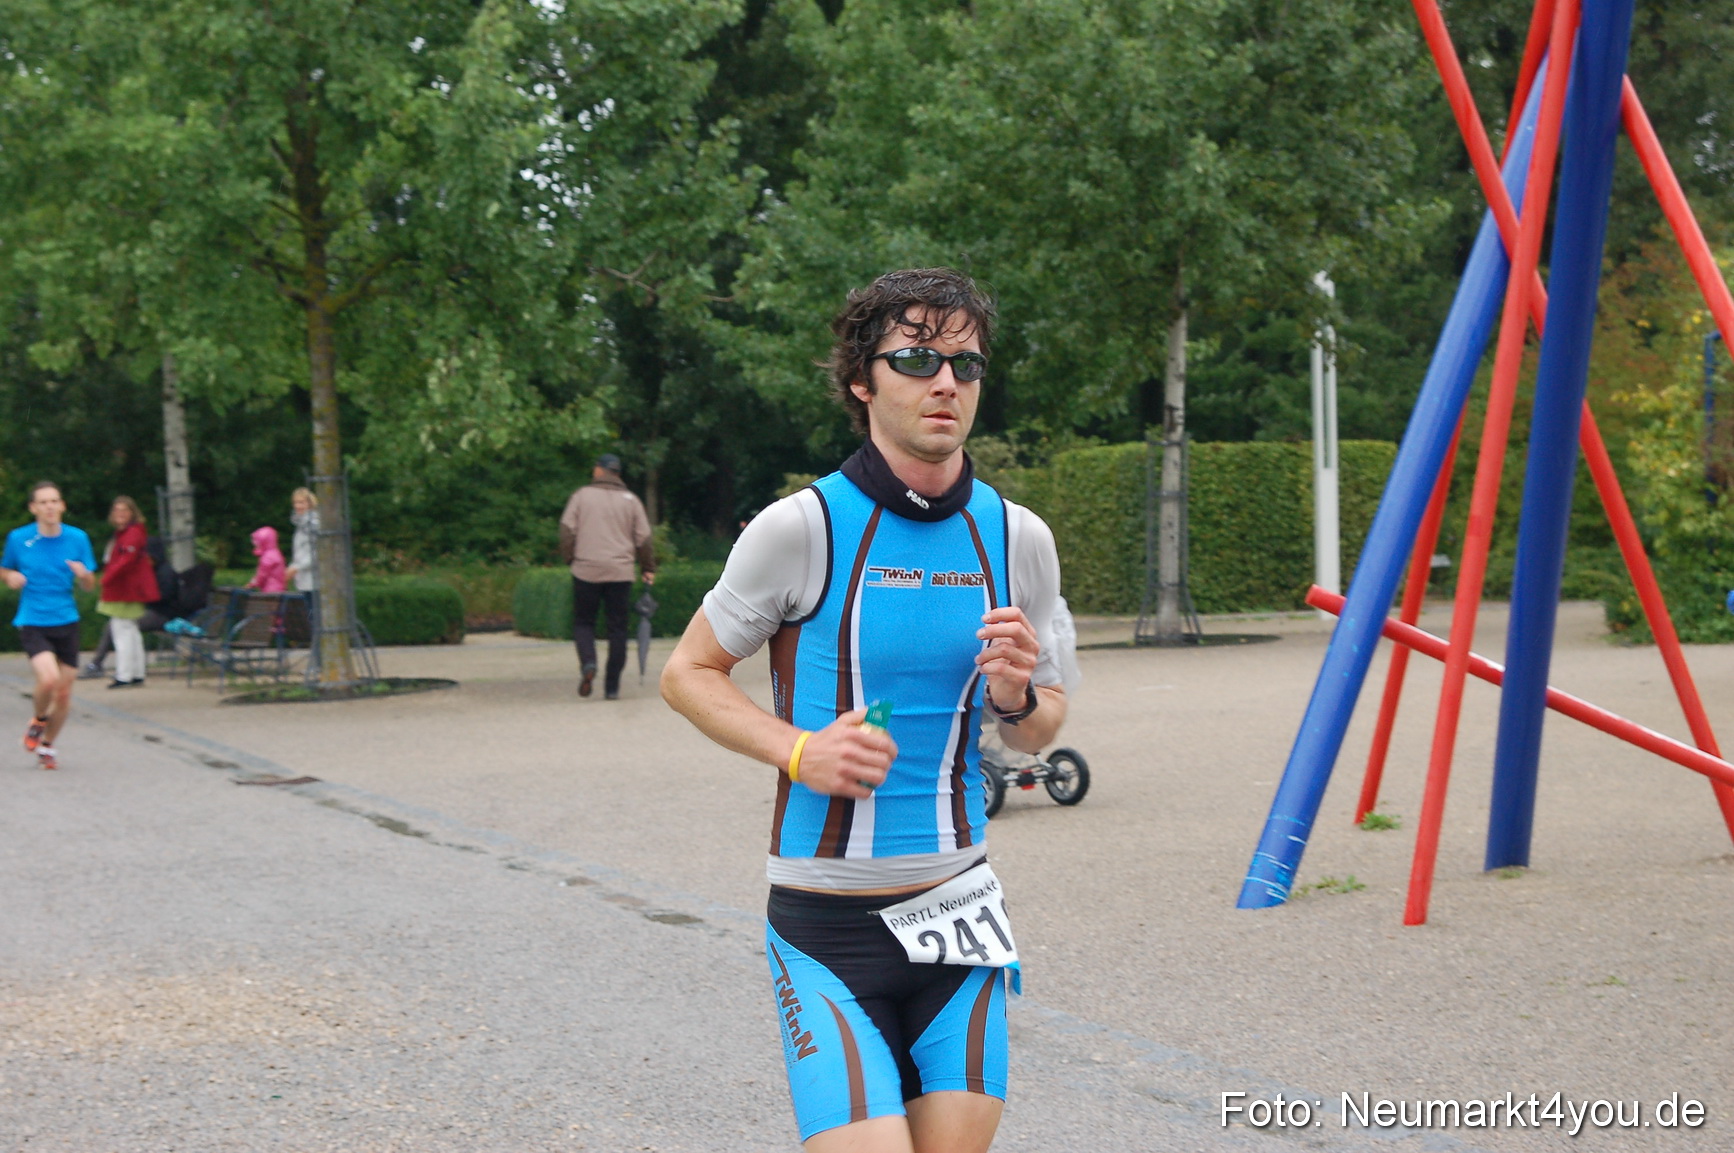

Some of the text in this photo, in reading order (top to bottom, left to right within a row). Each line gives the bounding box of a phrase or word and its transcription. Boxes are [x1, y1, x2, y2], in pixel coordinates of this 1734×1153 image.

[890, 880, 999, 930] PARTL Neumarkt
[770, 942, 818, 1060] TWinN
